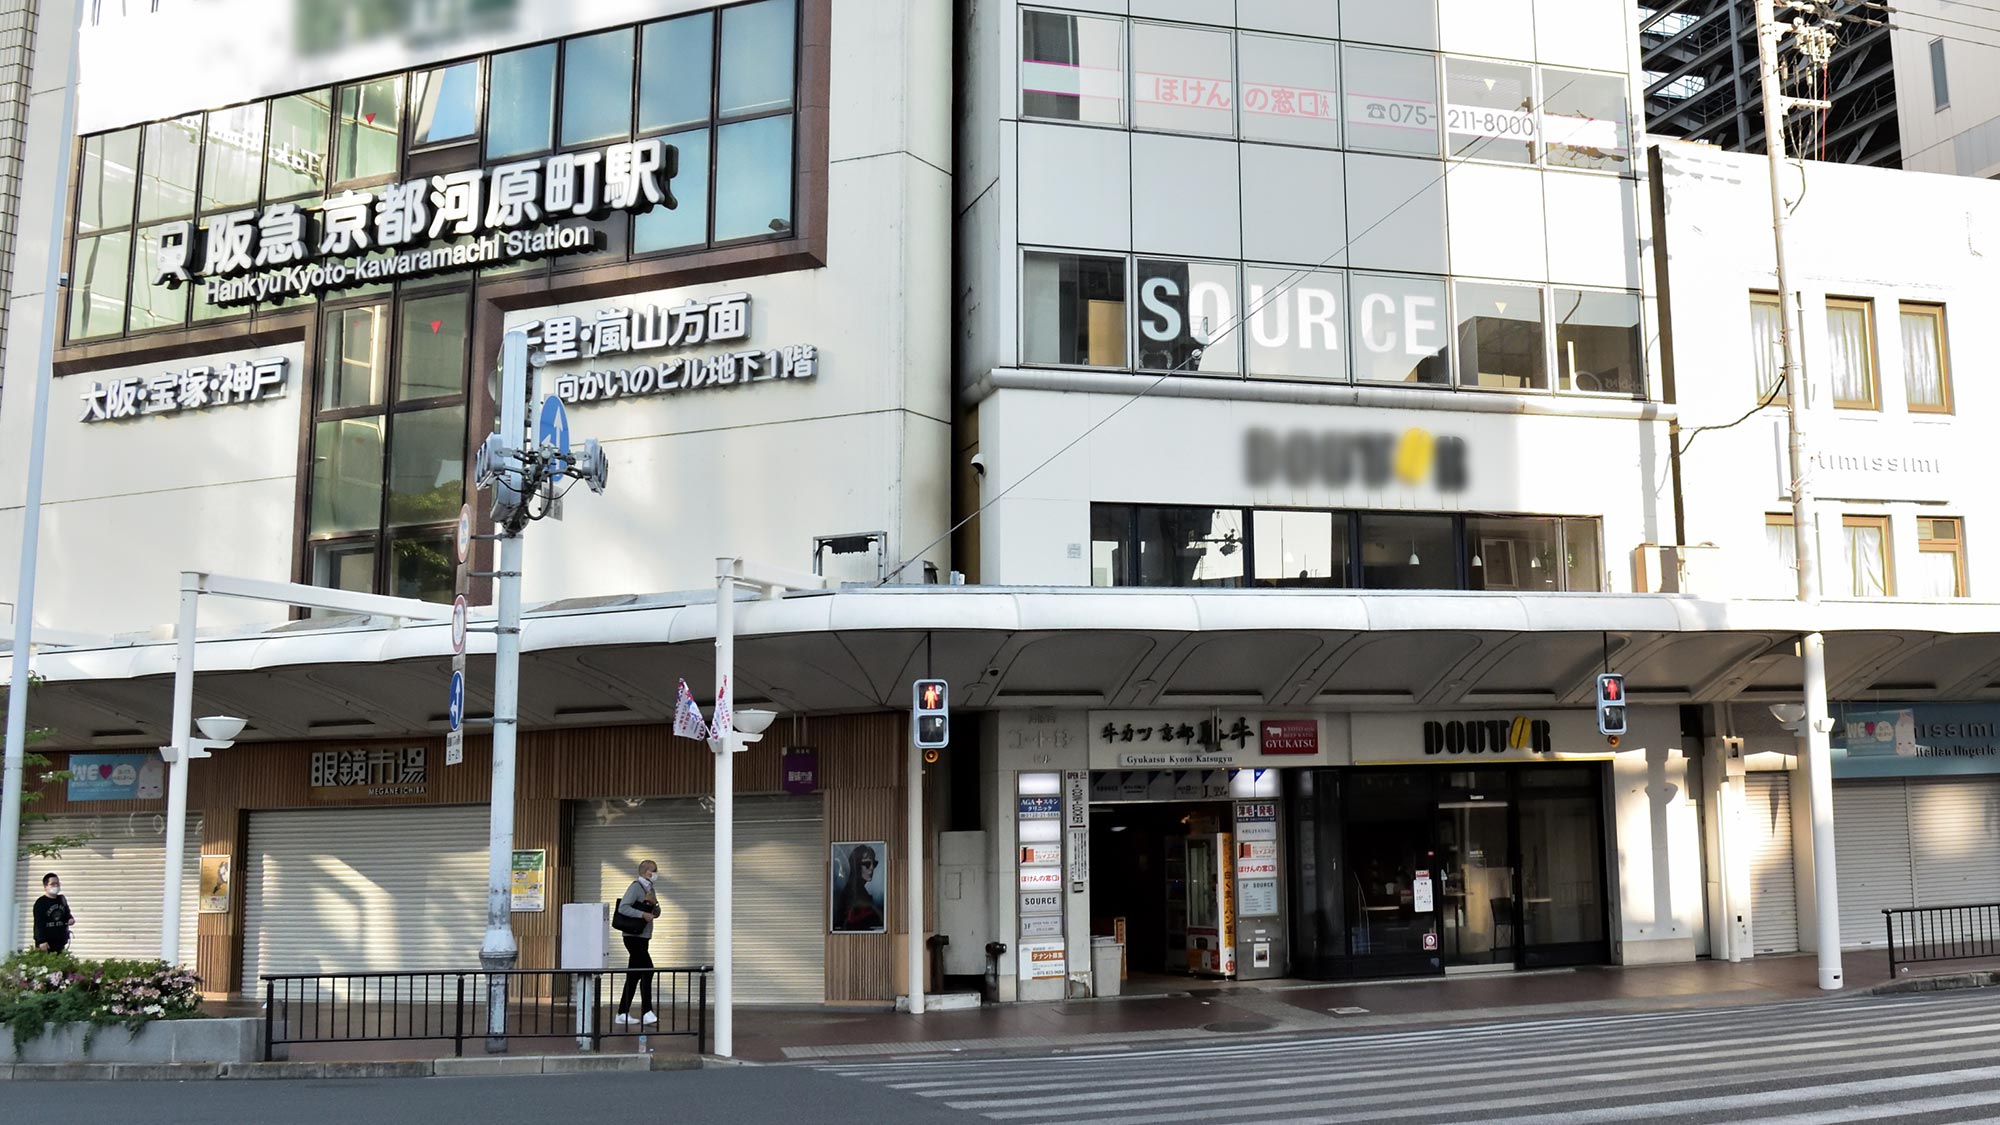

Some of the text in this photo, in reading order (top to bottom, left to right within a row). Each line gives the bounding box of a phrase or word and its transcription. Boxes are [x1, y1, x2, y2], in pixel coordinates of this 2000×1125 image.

[204, 202, 307, 275] 阪急
[320, 138, 667, 254] 京都河原町駅
[205, 223, 590, 304] Hankyu Kyoto-kawaramachi Station
[1140, 277, 1440, 357] SOURCE
[554, 343, 818, 403] 向かいのビル地下1階
[79, 355, 290, 423] 大阪・宝塚・神戸
[1817, 453, 1940, 473] timissimi
[1423, 714, 1551, 754] DOUTOR
[1846, 721, 1866, 739] WE
[1914, 721, 1997, 739] issimi
[1265, 739, 1316, 749] GYUKATSU
[310, 747, 427, 787] 眼鏡市場
[1126, 754, 1234, 765] Gyukatsu Kyoto Katsugyu
[71, 763, 99, 782] WE
[368, 786, 426, 797] MEGANE ICHIBA
[1024, 896, 1057, 906] SOURCE
